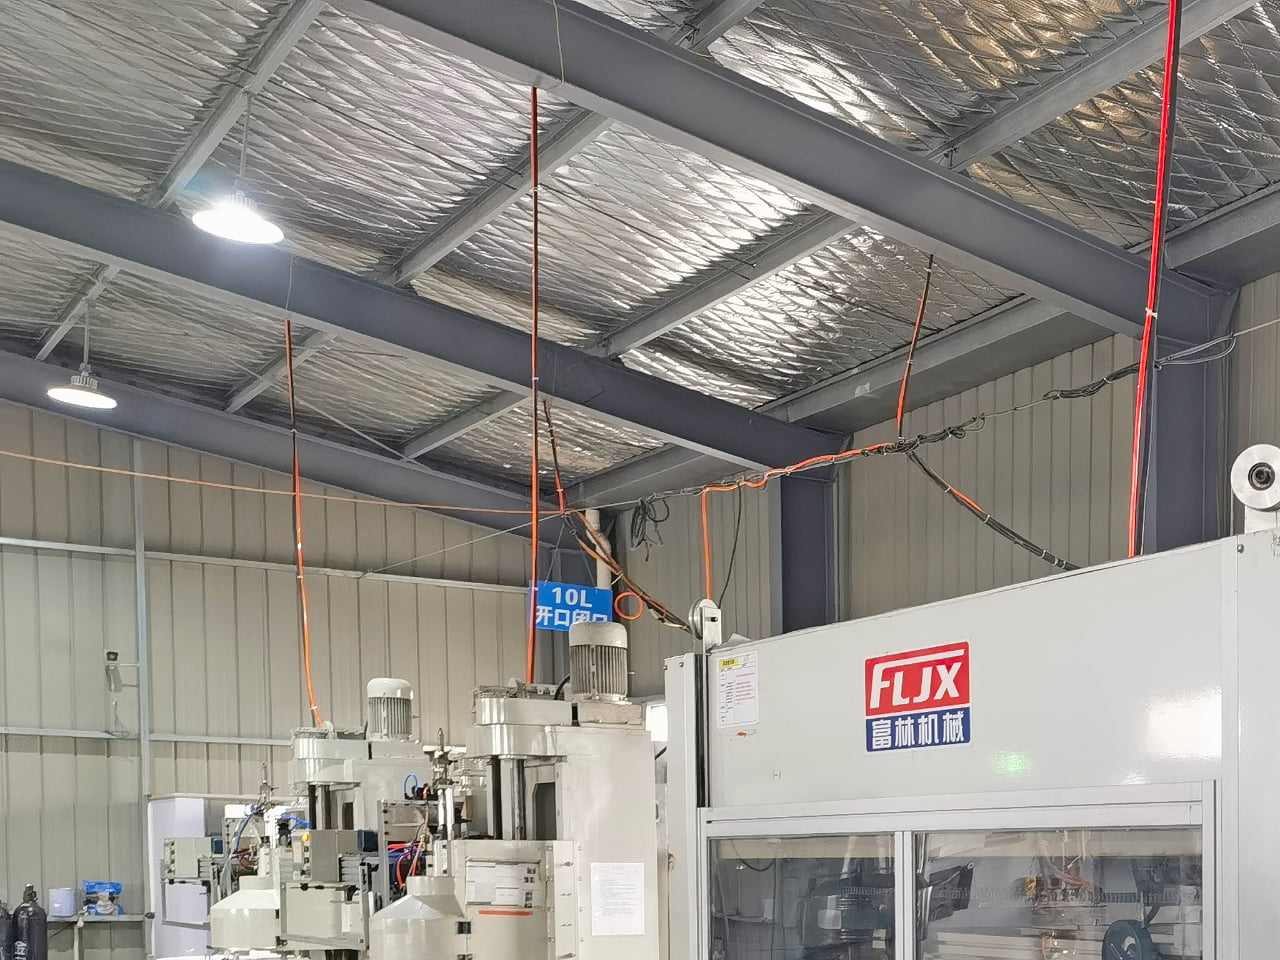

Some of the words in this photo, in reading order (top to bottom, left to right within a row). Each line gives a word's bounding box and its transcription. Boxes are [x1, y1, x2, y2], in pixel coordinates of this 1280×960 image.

[552, 587, 593, 608] 10L
[869, 649, 965, 709] FLJX
[871, 710, 965, 750] 富林机械
